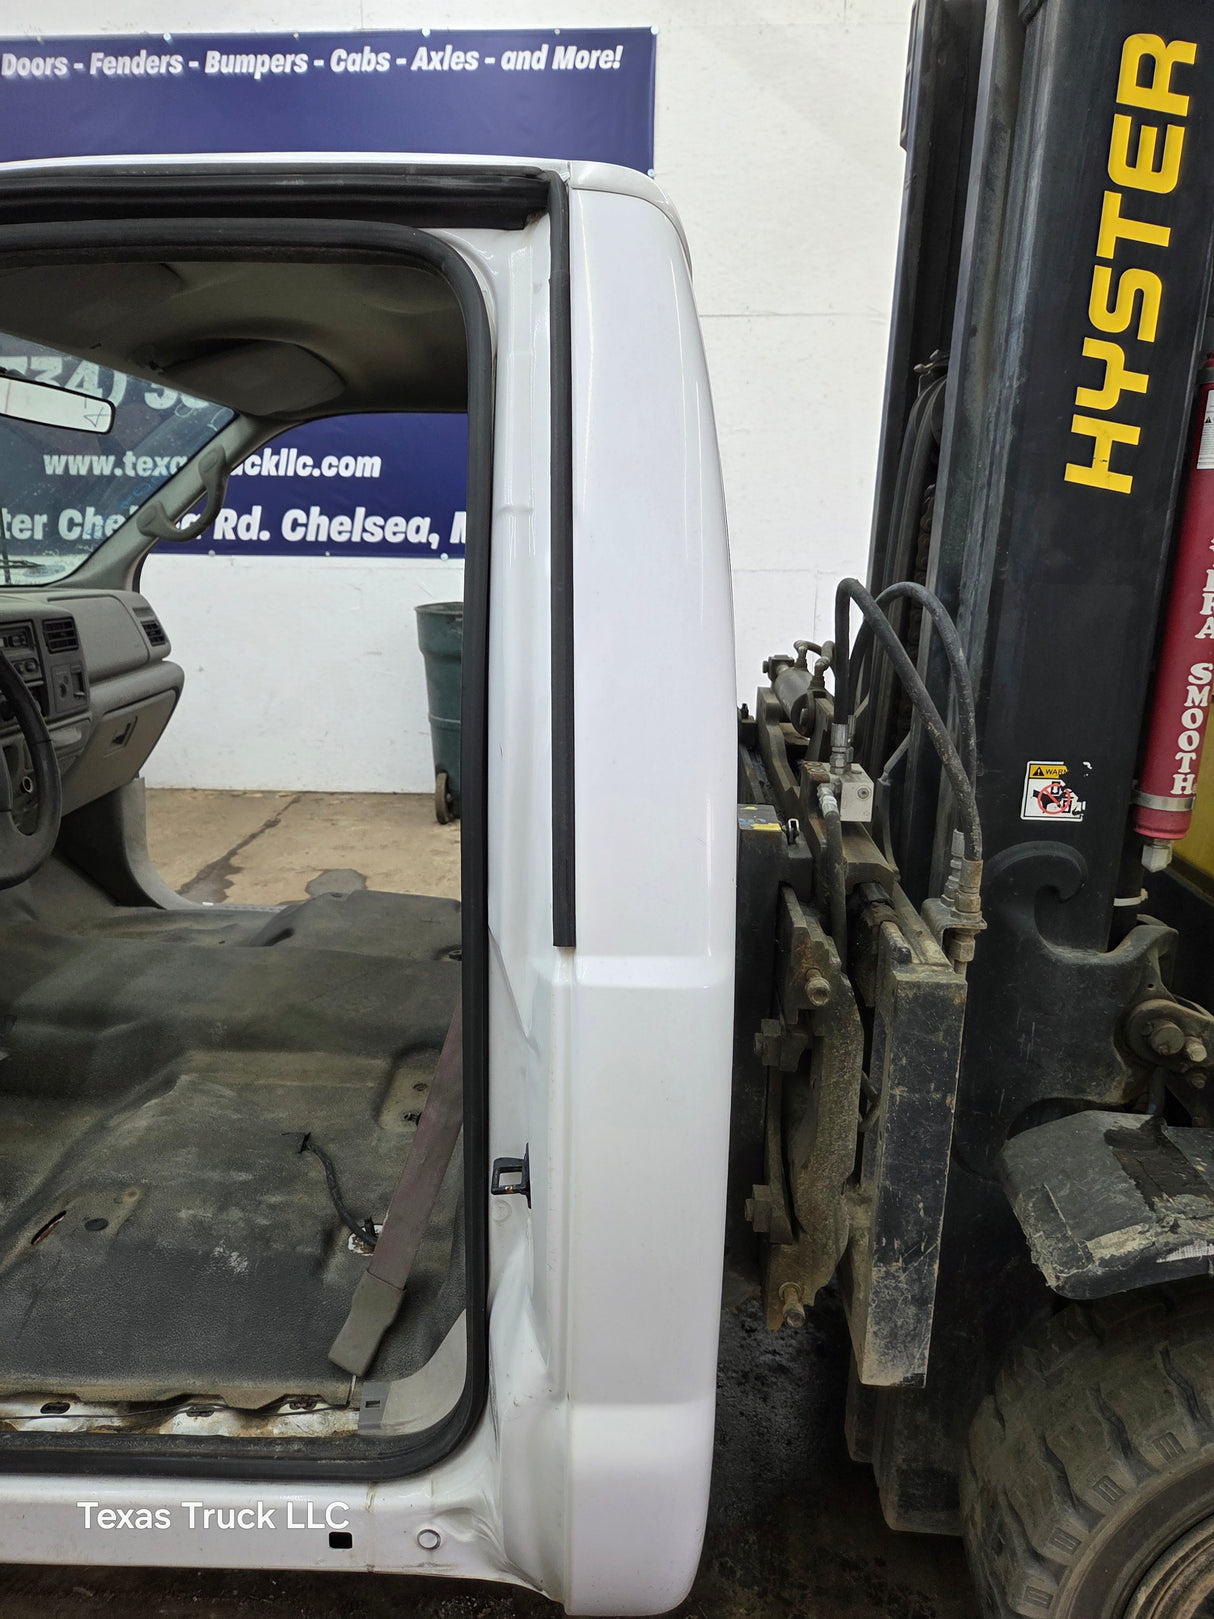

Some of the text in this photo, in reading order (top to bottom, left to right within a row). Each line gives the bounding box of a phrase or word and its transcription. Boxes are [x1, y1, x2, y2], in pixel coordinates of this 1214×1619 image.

[1, 52, 67, 76] Doors
[90, 49, 184, 75] Fenders
[188, 60, 199, 68] -
[204, 50, 309, 80] Bumpers
[313, 58, 325, 66] -
[330, 46, 391, 72] Cabs
[396, 57, 407, 65] -
[410, 45, 479, 71] Axles
[500, 44, 549, 71] and
[552, 45, 624, 70] More!
[1064, 32, 1198, 495] HYSTER
[213, 505, 271, 541] Rd.
[281, 506, 440, 550] Chelsea,
[1169, 662, 1213, 796] SMOOTH
